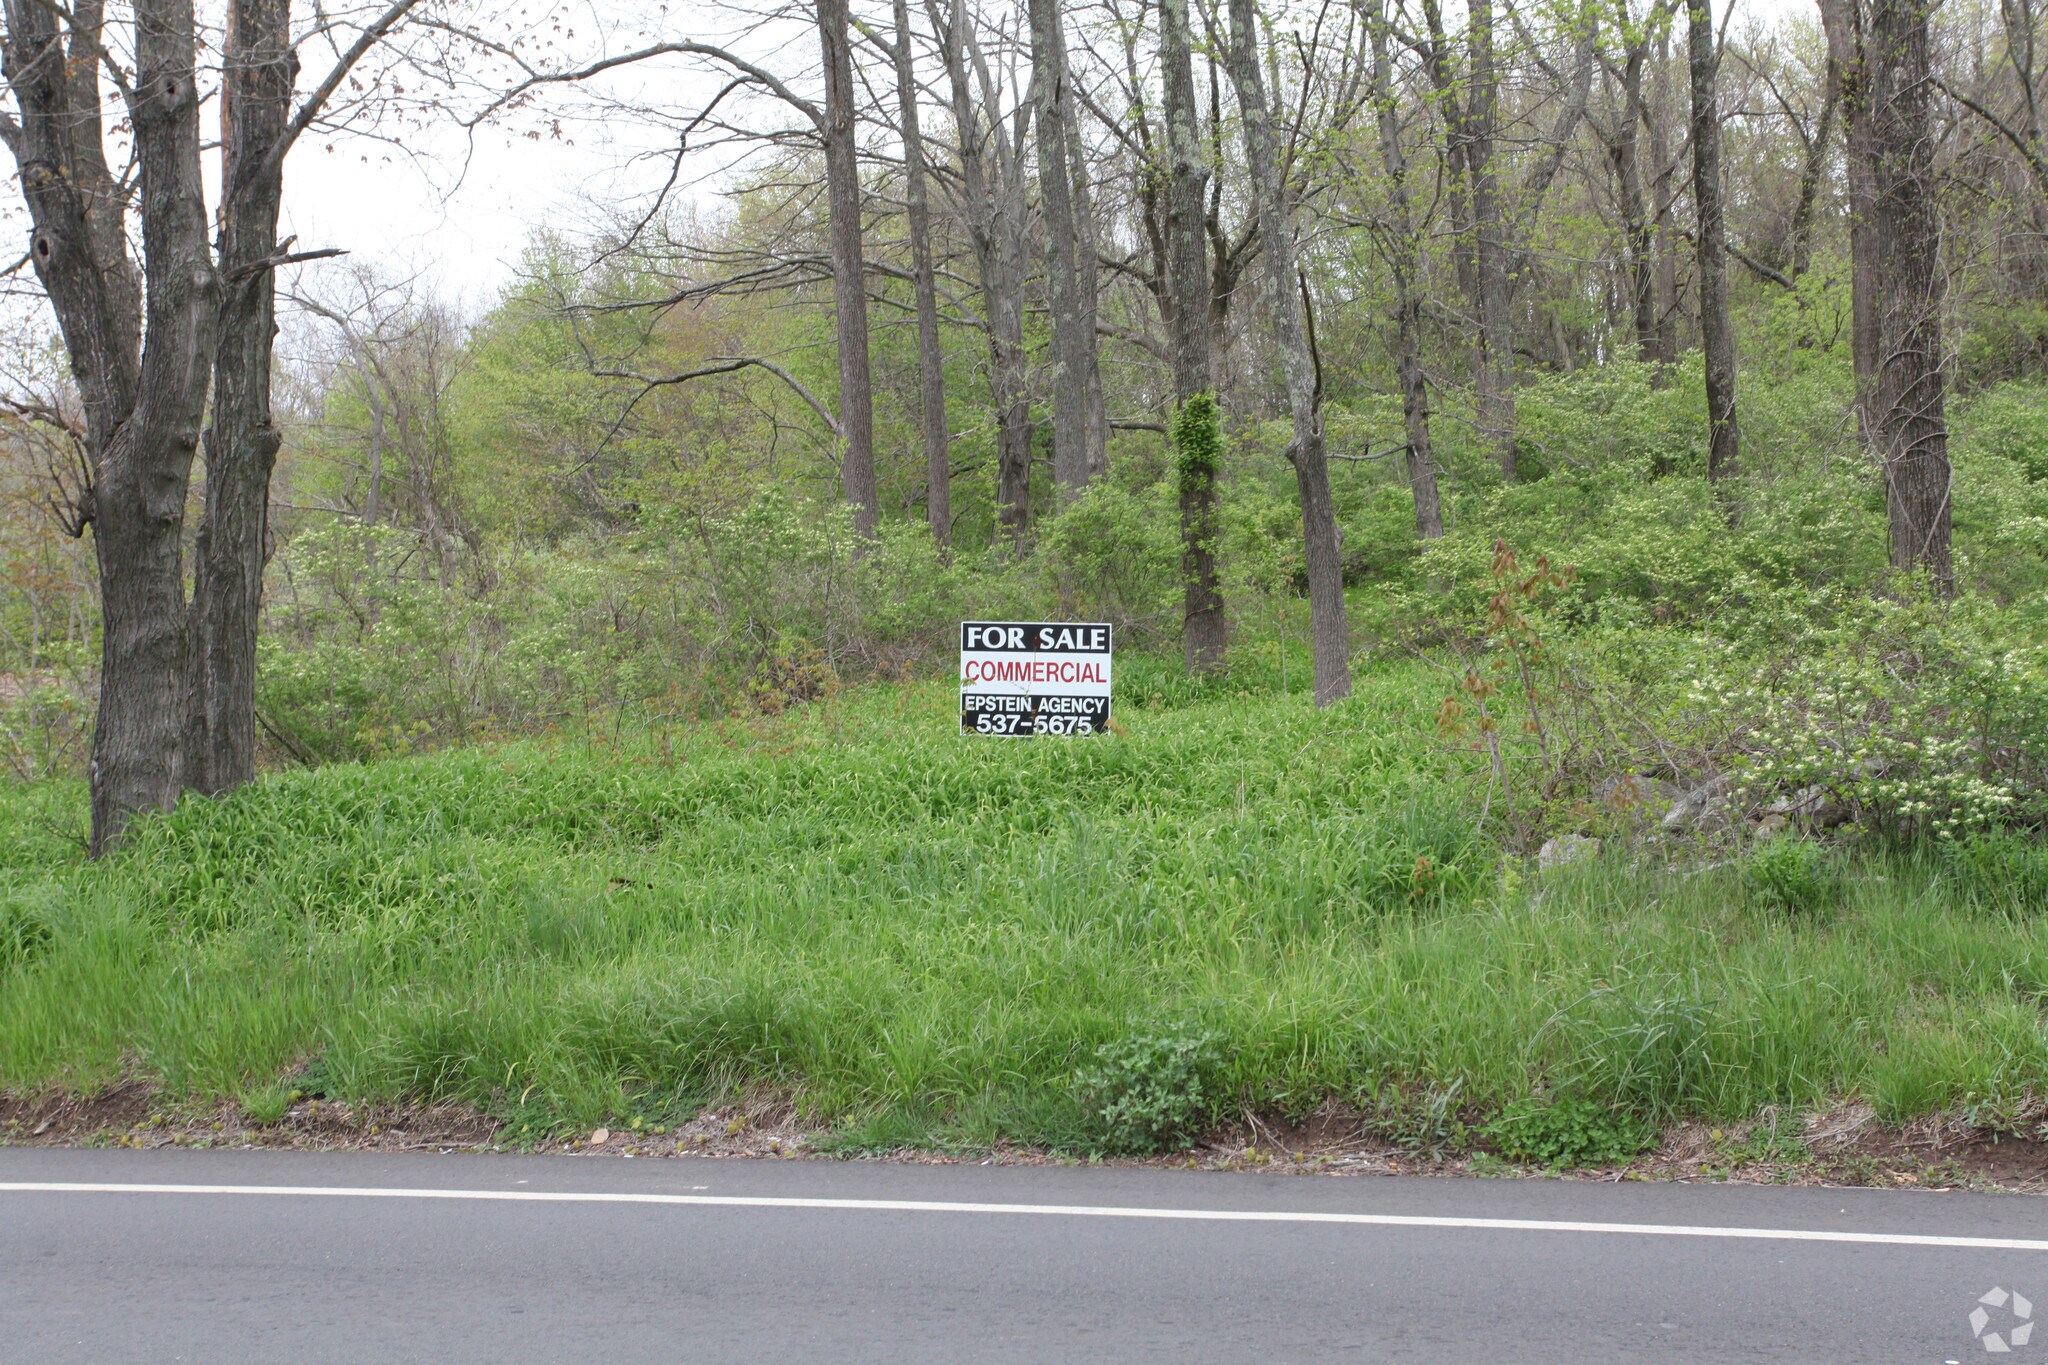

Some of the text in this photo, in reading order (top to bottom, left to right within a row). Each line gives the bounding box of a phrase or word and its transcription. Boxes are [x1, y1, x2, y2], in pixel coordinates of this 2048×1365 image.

[968, 627, 1105, 650] FOR SALE
[965, 660, 1107, 683] COMMERCIAL
[965, 696, 1105, 714] EPSTEIN AGENCY
[976, 713, 1093, 735] 537-5675
